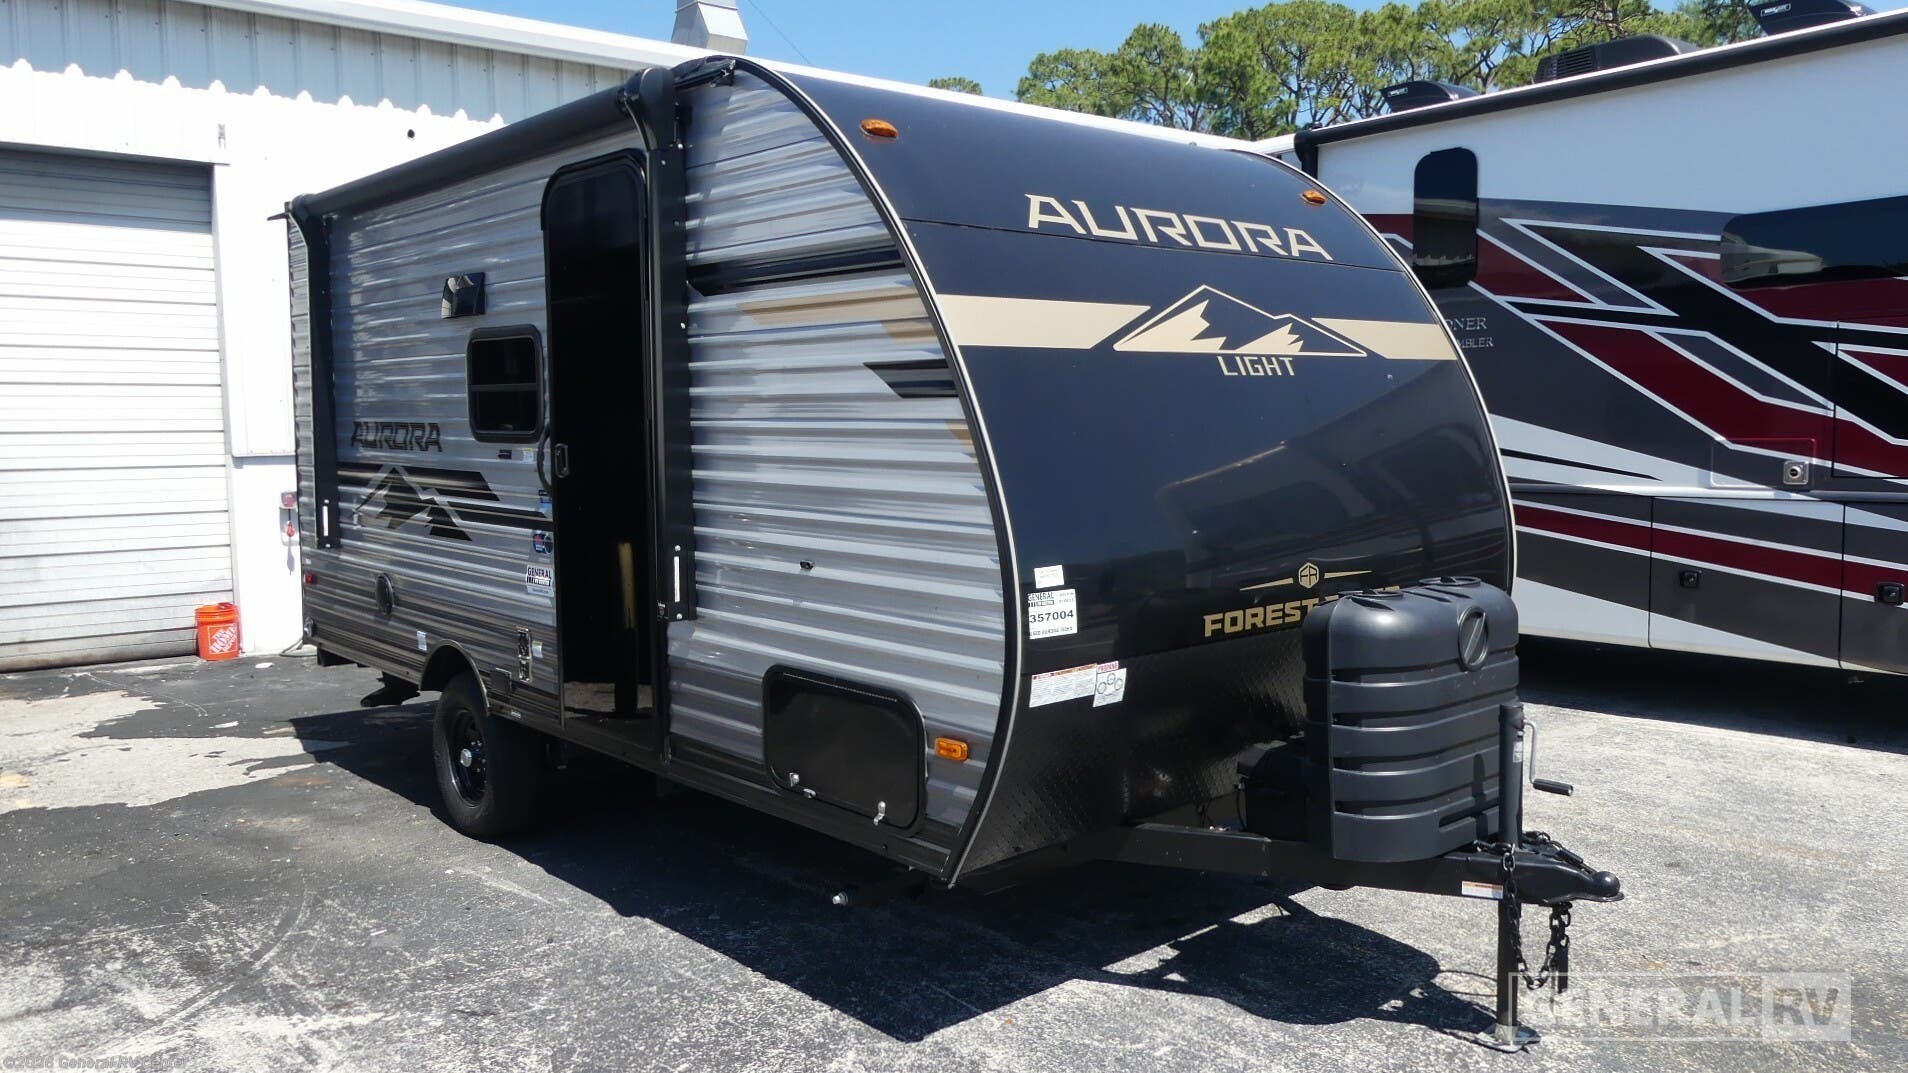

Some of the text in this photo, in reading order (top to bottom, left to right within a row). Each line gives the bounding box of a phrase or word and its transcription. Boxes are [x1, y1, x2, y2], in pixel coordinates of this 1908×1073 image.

[1025, 193, 1334, 261] AURORA
[1456, 336, 1494, 349] MBLER
[1217, 356, 1295, 377] LIGHT
[351, 421, 443, 452] AURORA
[1029, 609, 1074, 624] 357004
[1203, 597, 1320, 638] FOREST
